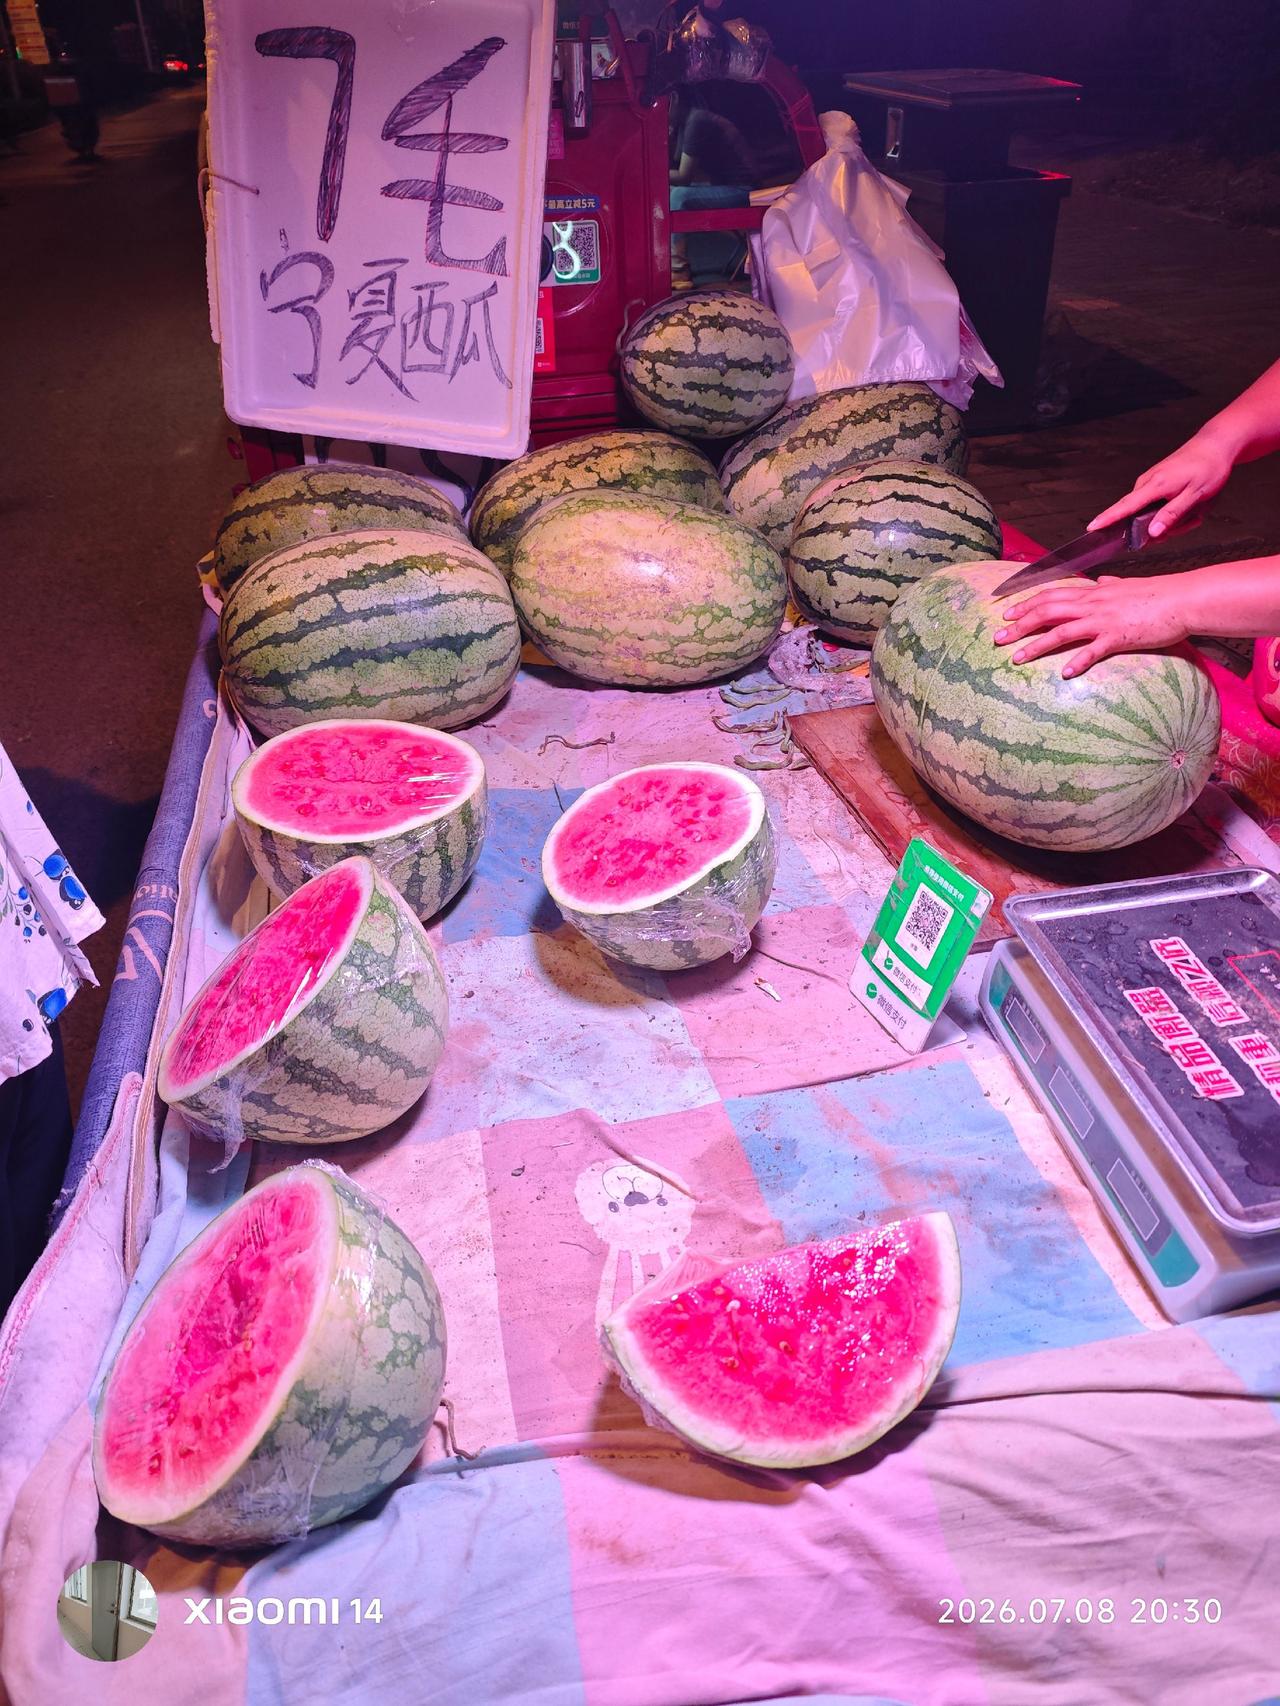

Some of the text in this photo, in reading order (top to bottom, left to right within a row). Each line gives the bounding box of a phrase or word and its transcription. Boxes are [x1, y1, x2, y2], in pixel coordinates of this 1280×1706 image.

[255, 26, 511, 277] 7毛
[544, 199, 596, 209] 最高立减5元
[259, 228, 513, 402] 宁夏西瓜
[876, 994, 907, 1030] 微信支付
[892, 966, 918, 994] 微信支付
[1125, 987, 1242, 1098] 精品衡器
[1230, 1035, 1280, 1103] 称重
